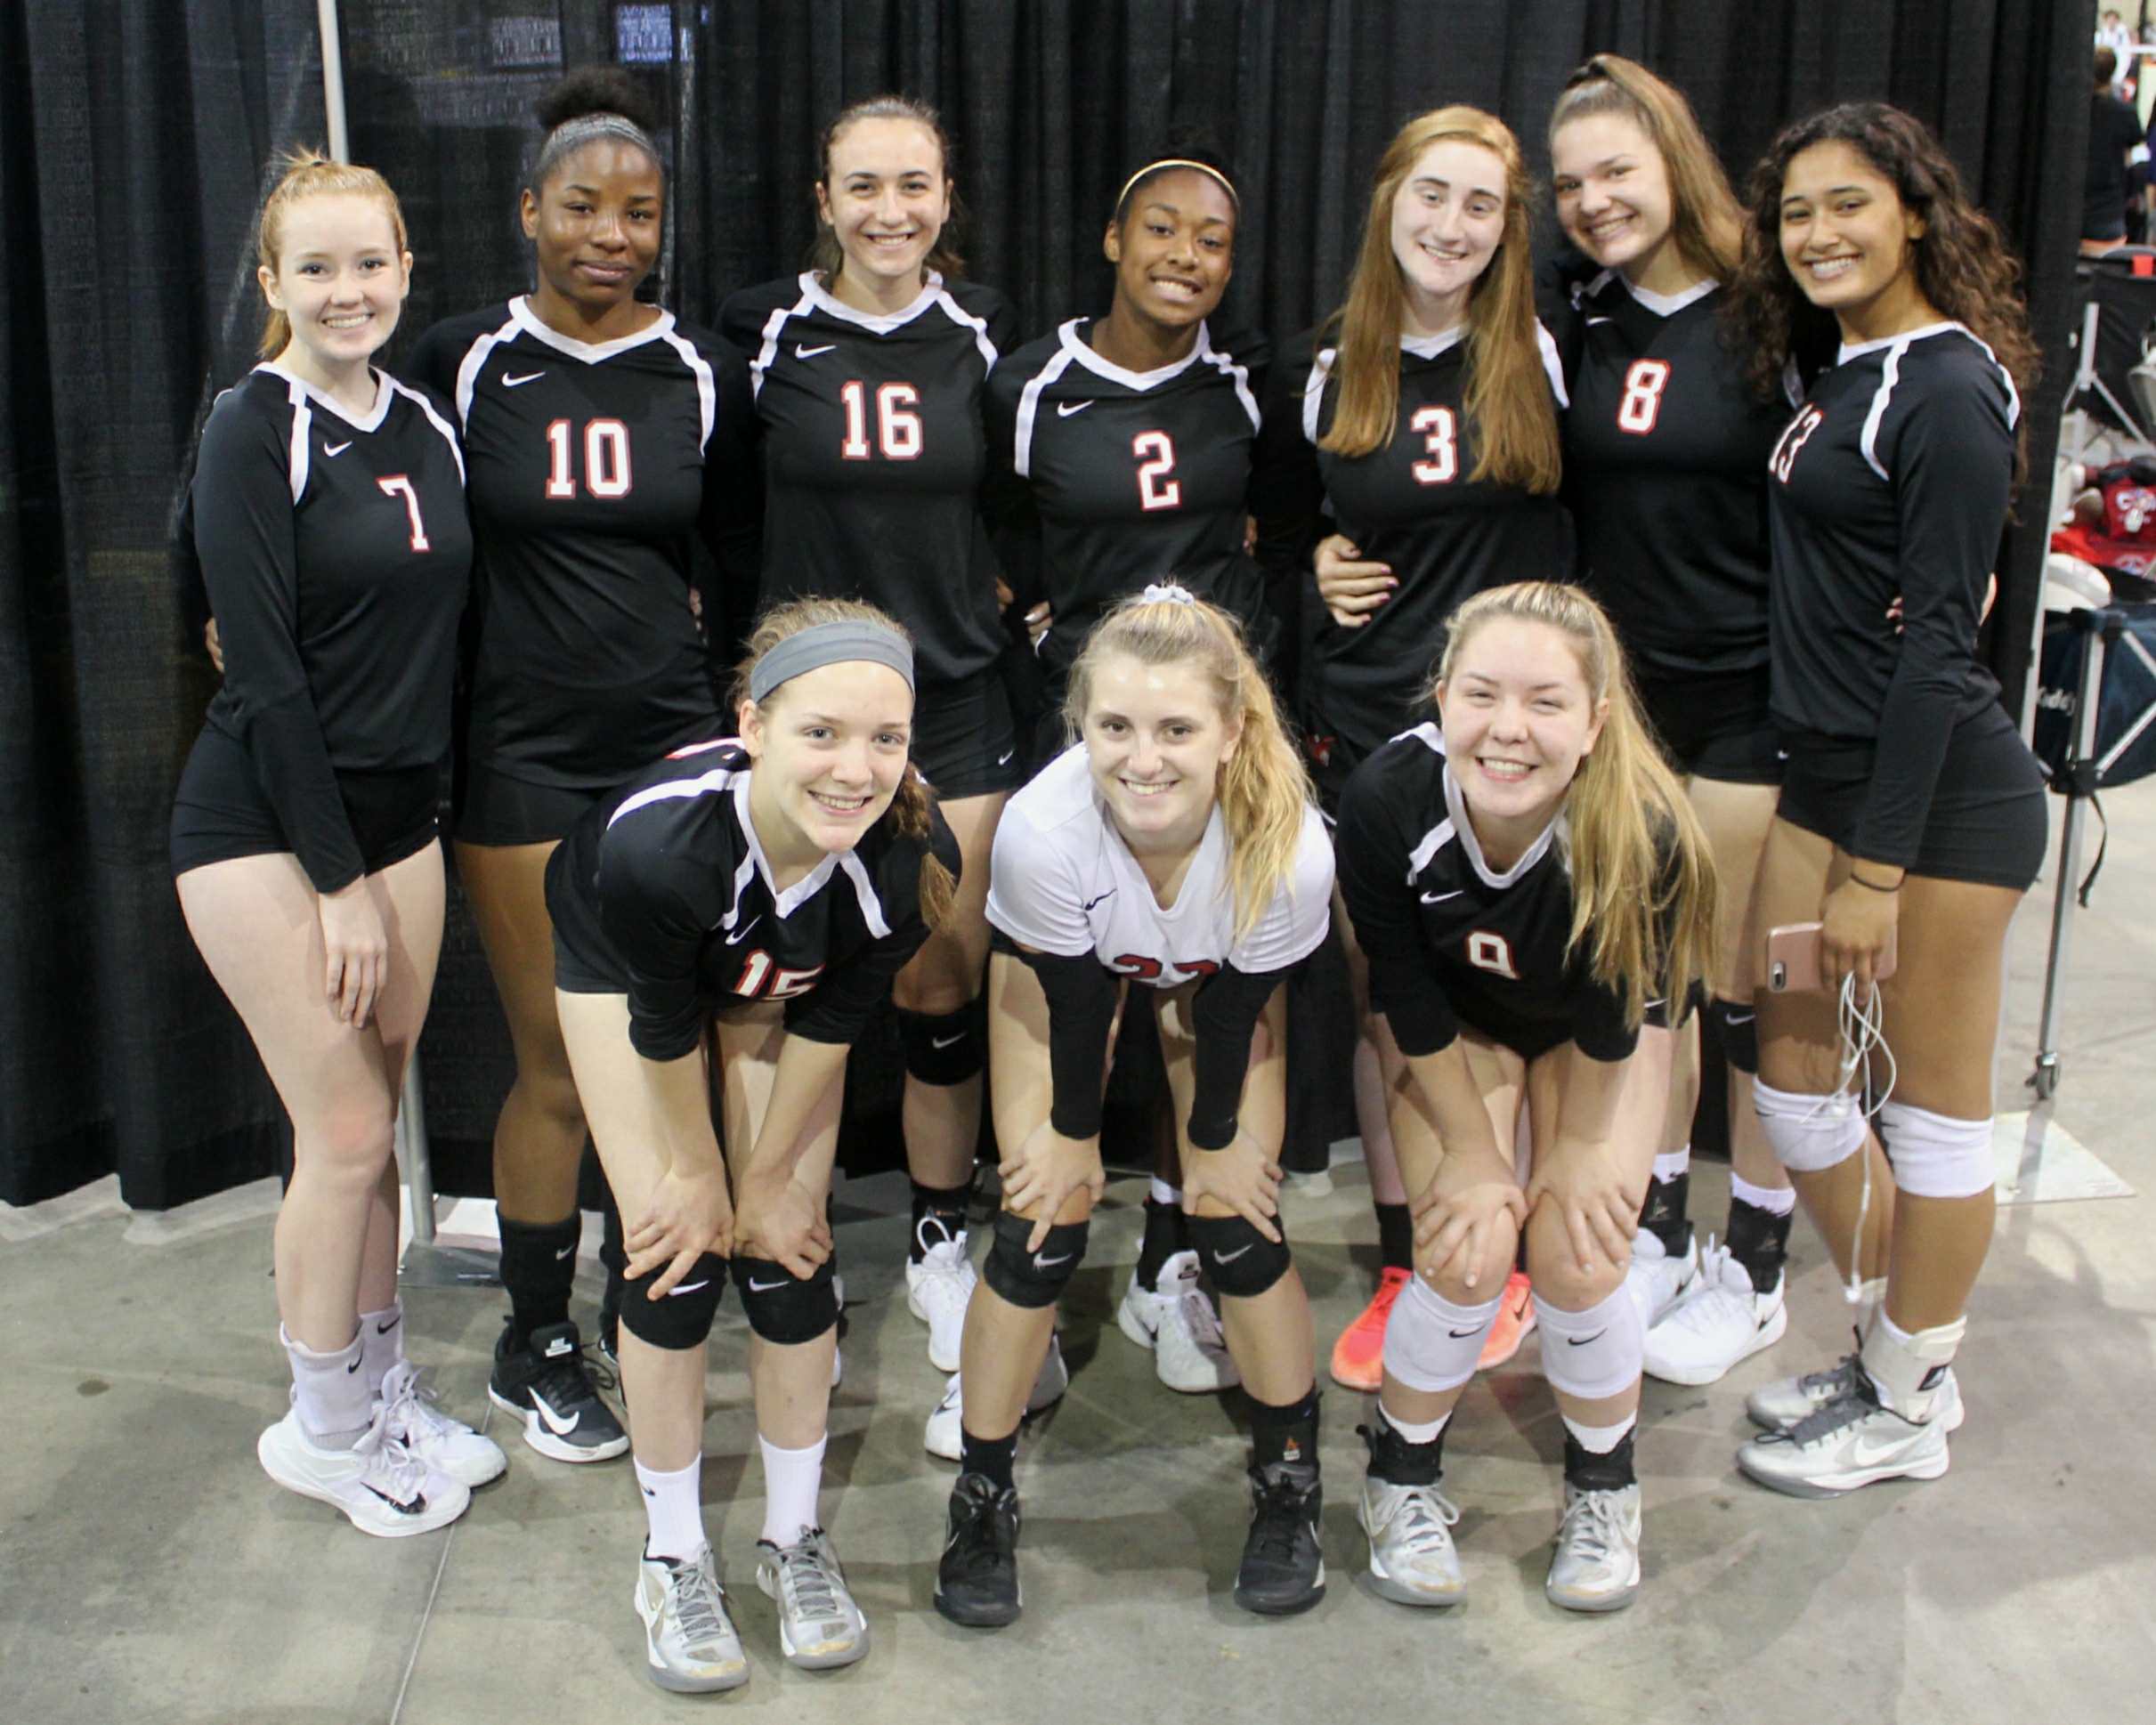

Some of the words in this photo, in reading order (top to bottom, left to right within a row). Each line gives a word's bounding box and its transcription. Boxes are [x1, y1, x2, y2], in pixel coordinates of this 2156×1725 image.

[839, 379, 924, 461] 16
[1616, 357, 1672, 436] 8
[545, 417, 633, 500] 10
[1131, 429, 1182, 512] 2
[1409, 404, 1459, 486] 3
[1768, 402, 1826, 484] 13
[377, 474, 431, 553] 7
